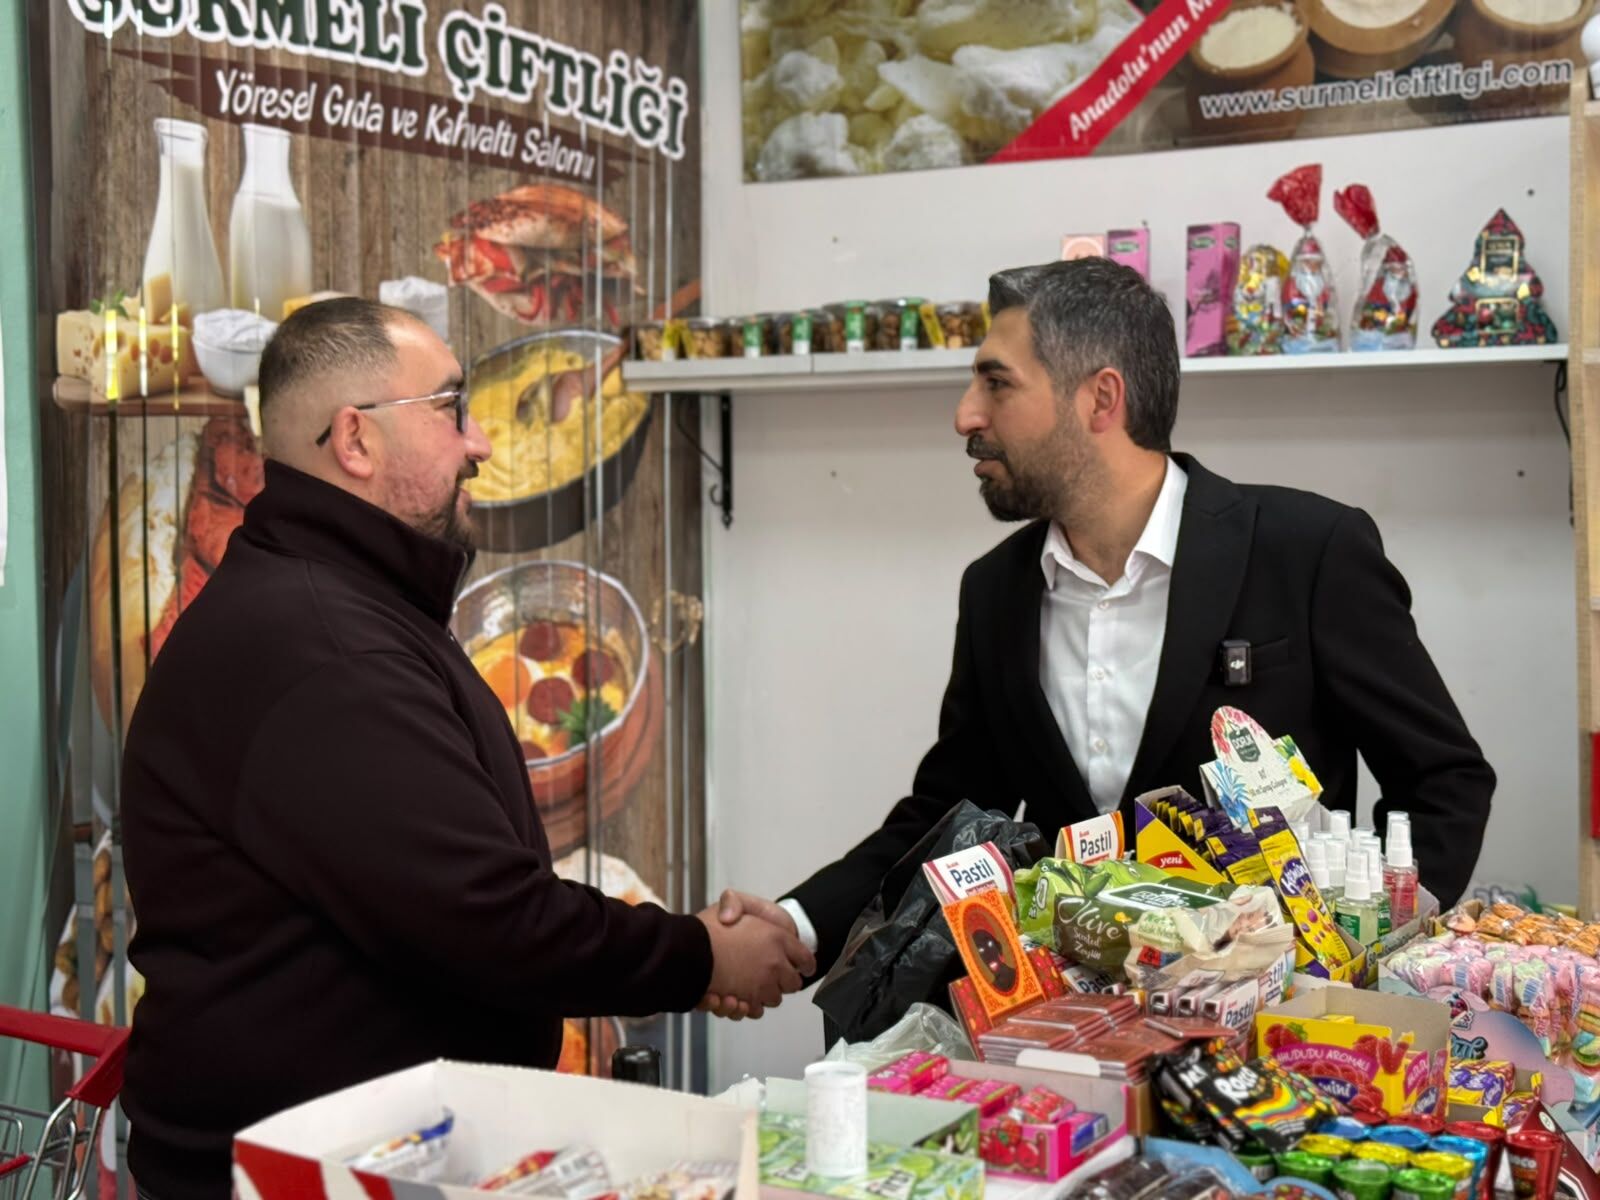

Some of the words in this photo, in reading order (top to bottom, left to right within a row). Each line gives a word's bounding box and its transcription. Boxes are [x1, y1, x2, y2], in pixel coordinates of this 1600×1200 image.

[1069, 15, 1189, 141] Anadolu'nun
[1198, 59, 1573, 119] www.surmeliciftligi.com
[215, 69, 318, 123] Yöresel
[322, 84, 384, 132] Gıda
[391, 106, 418, 139] ve
[424, 103, 517, 158] Kahvaltı
[520, 126, 595, 179] Salonu
[1080, 830, 1112, 859] Pastil
[1160, 854, 1184, 868] yeni
[949, 857, 994, 888] Pastil
[1058, 897, 1123, 940] Olive
